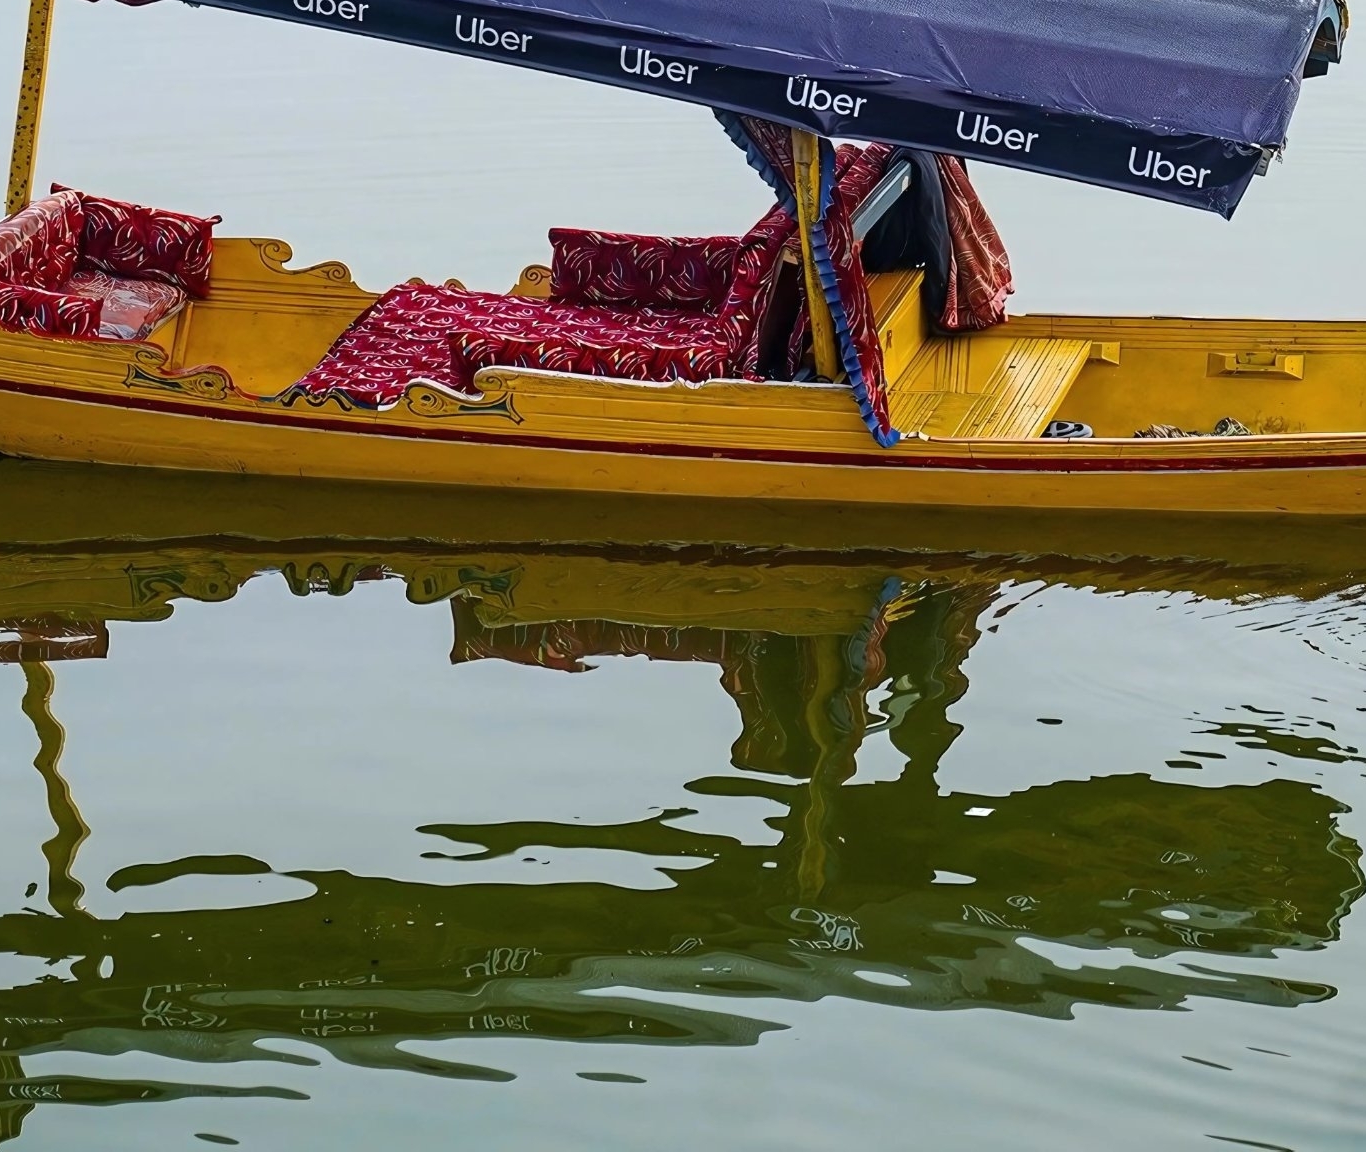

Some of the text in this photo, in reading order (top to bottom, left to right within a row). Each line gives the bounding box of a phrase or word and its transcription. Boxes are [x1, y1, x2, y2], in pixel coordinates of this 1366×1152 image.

[455, 14, 534, 53] Uber
[620, 45, 700, 85] Uber
[786, 76, 869, 118] Uber
[956, 111, 1040, 153] Uber
[1128, 146, 1213, 188] Uber
